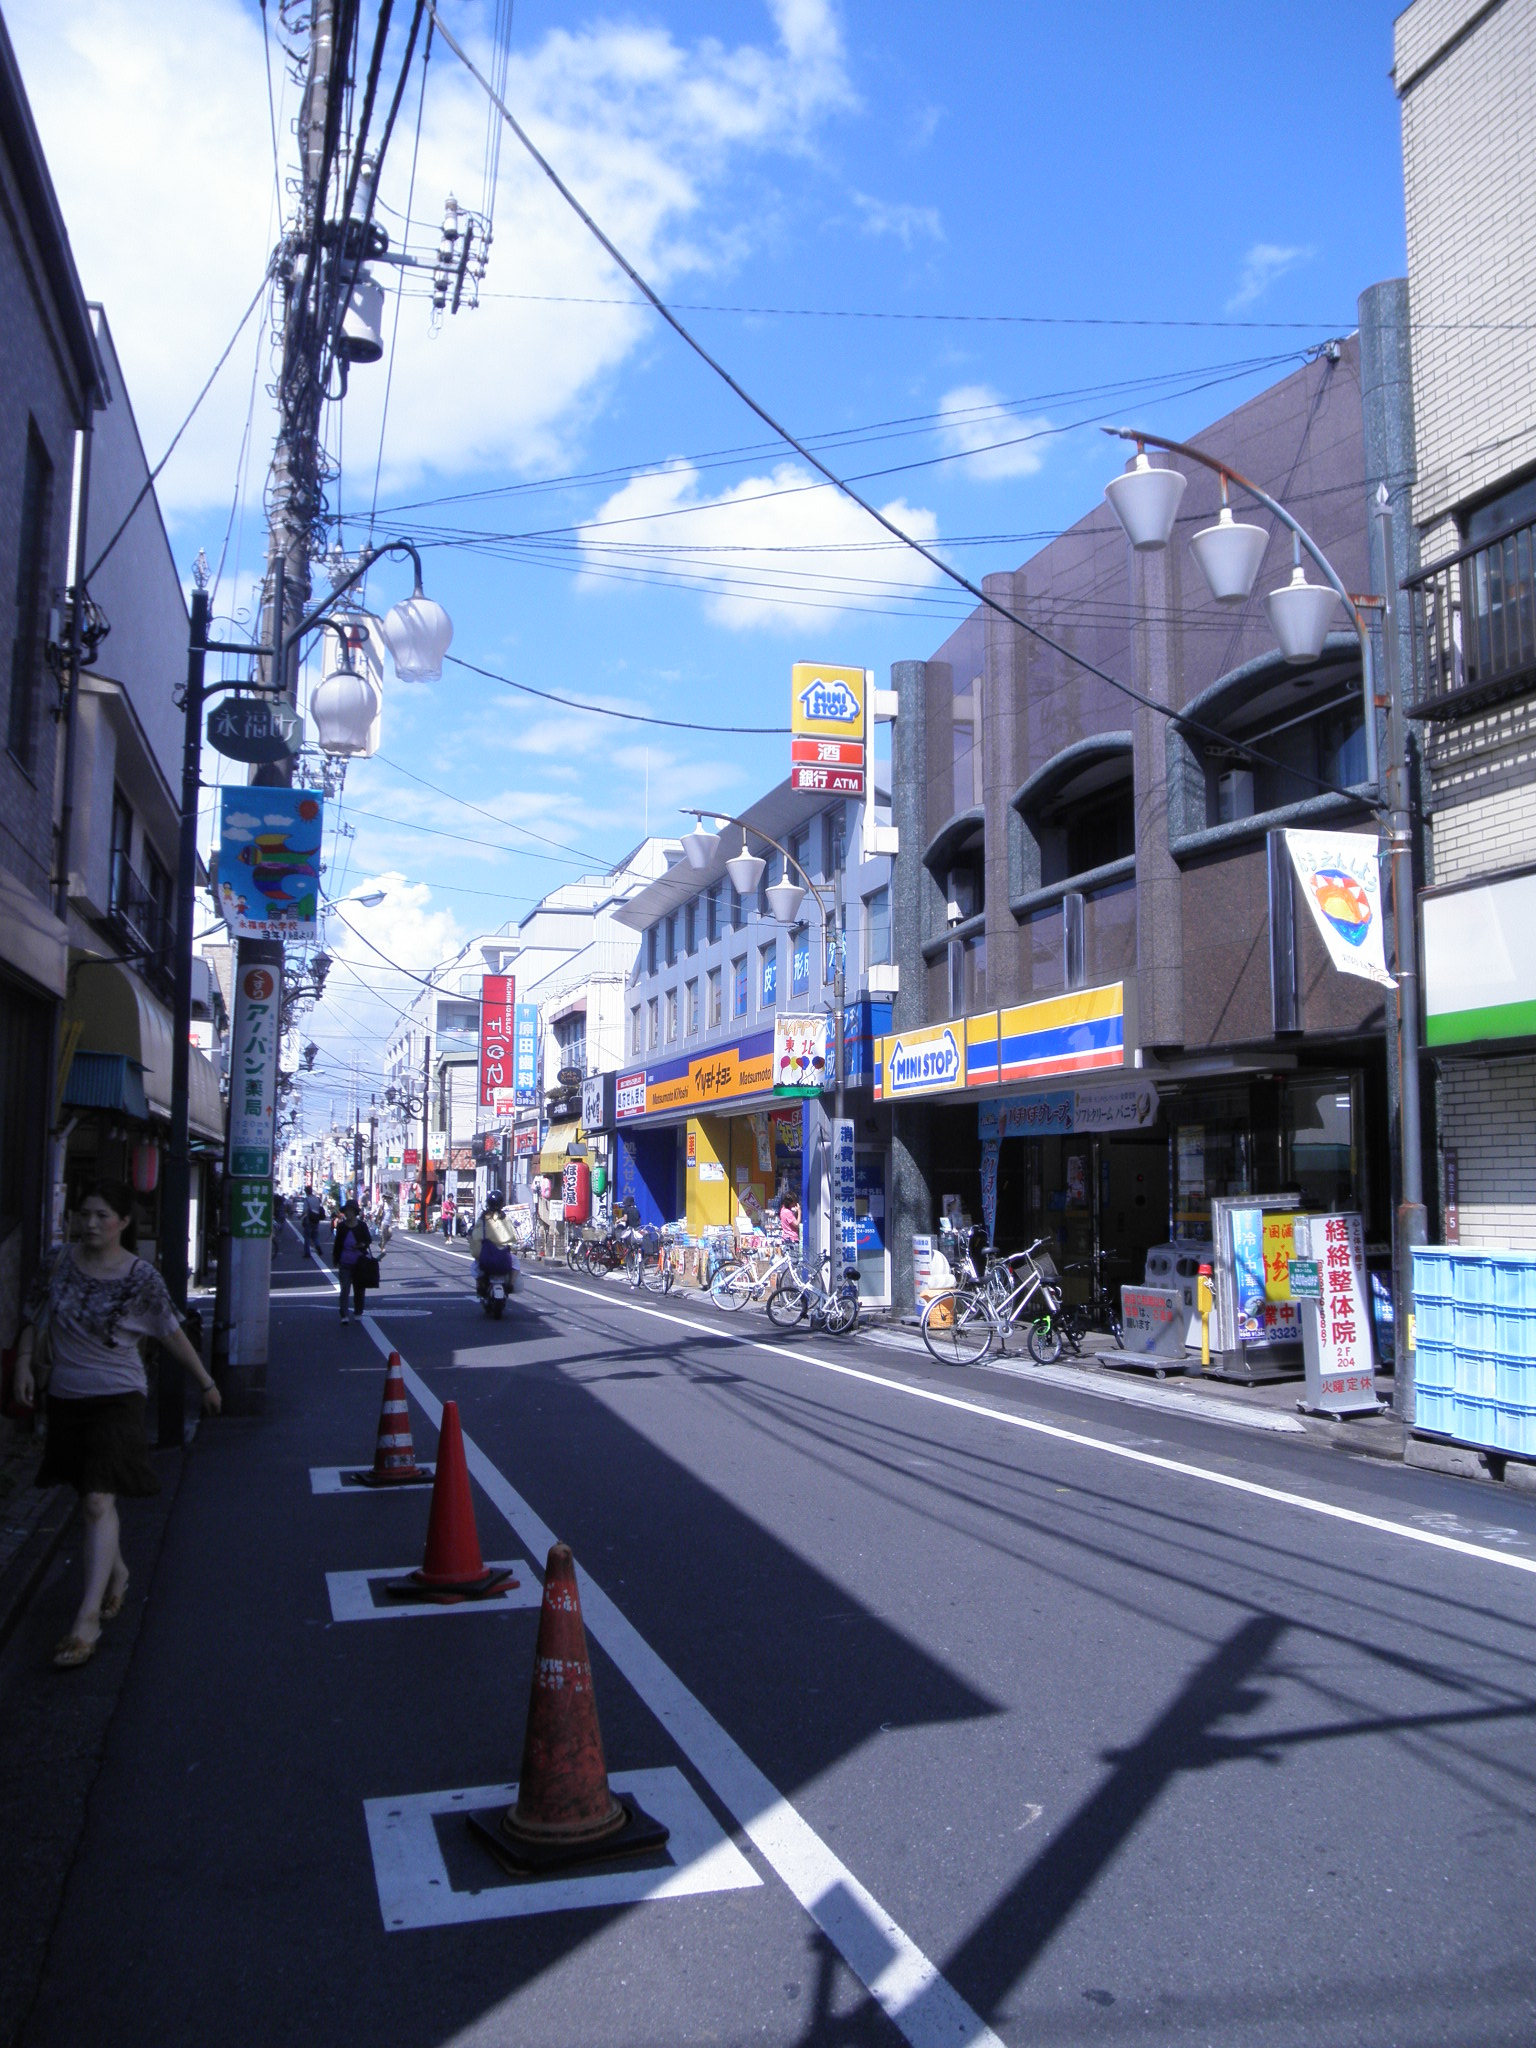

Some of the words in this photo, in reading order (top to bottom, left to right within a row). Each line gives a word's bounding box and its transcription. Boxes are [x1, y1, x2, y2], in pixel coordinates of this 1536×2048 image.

[814, 690, 847, 704] MINI
[813, 703, 848, 716] STOP
[216, 710, 297, 742] 永福町
[818, 743, 841, 761] 酒
[799, 769, 828, 788] 銀行
[833, 777, 859, 790] ATM
[777, 1019, 819, 1037] HAPPY
[517, 1021, 535, 1088] 原田歯科
[784, 1036, 816, 1056] 東北
[243, 1003, 270, 1117] アーバン薬局
[896, 1060, 922, 1081] MINI
[923, 1049, 954, 1077] STOP
[694, 1062, 732, 1096] マツモトキヨシ
[738, 1067, 772, 1087] Matsumoto
[566, 1164, 578, 1206] ほっと屋
[241, 1197, 268, 1228] 文
[1449, 1217, 1456, 1229] 5
[1242, 1231, 1258, 1288] 冷し中華
[1325, 1218, 1357, 1346] 経絡整体院
[1337, 1357, 1356, 1368] 204
[1321, 1376, 1373, 1395] 火曜定休
